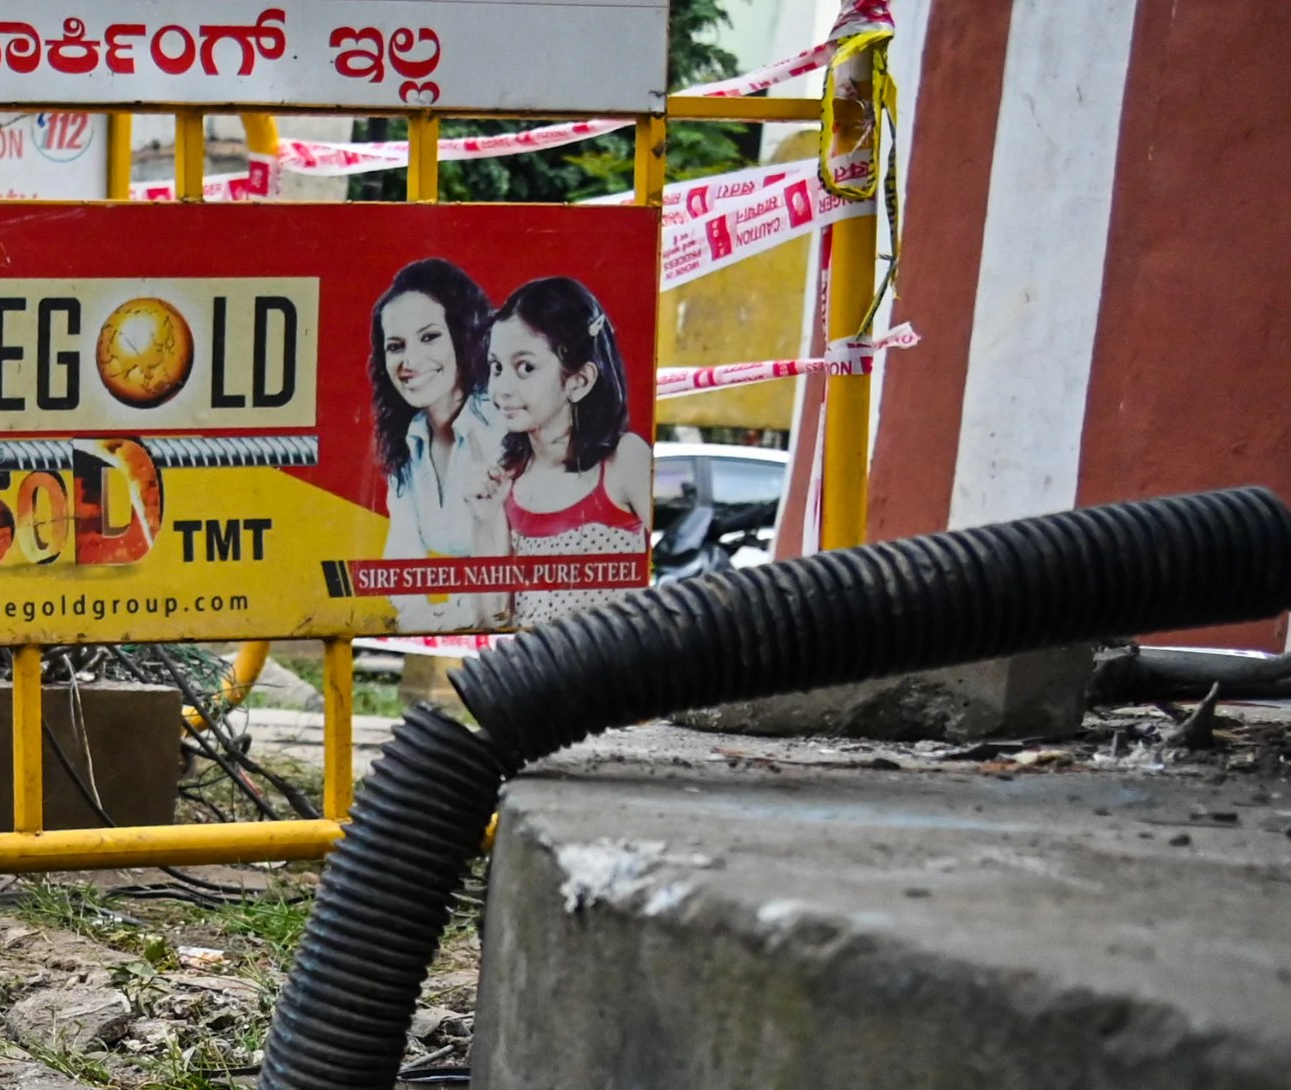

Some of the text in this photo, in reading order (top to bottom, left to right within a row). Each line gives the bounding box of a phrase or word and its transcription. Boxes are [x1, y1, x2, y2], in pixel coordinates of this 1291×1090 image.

[329, 26, 440, 103] ಇಲ್ಲ
[736, 217, 781, 247] CAUTION
[173, 518, 273, 563] TMT
[359, 561, 642, 589] SIRF STEEL NAHIN, PURE STEEL
